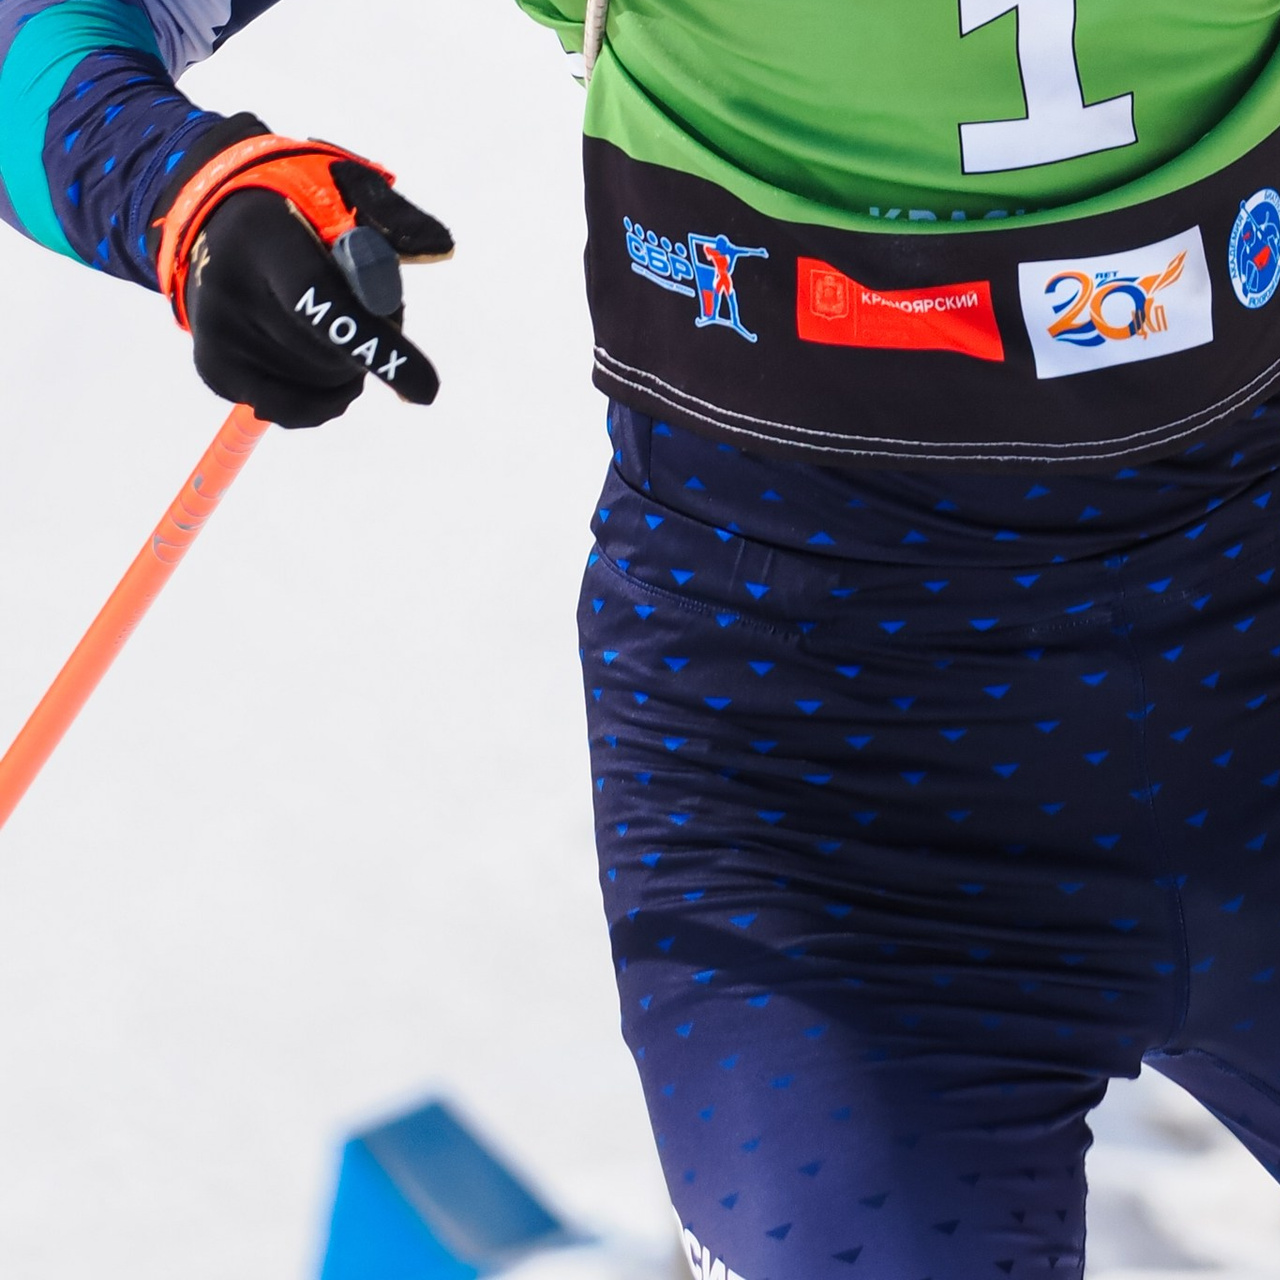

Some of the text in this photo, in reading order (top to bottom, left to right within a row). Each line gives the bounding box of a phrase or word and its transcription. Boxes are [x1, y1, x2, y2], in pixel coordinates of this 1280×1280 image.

[1045, 270, 1147, 347] 20
[1095, 270, 1119, 280] ЛЕТ
[295, 286, 408, 381] MOAX
